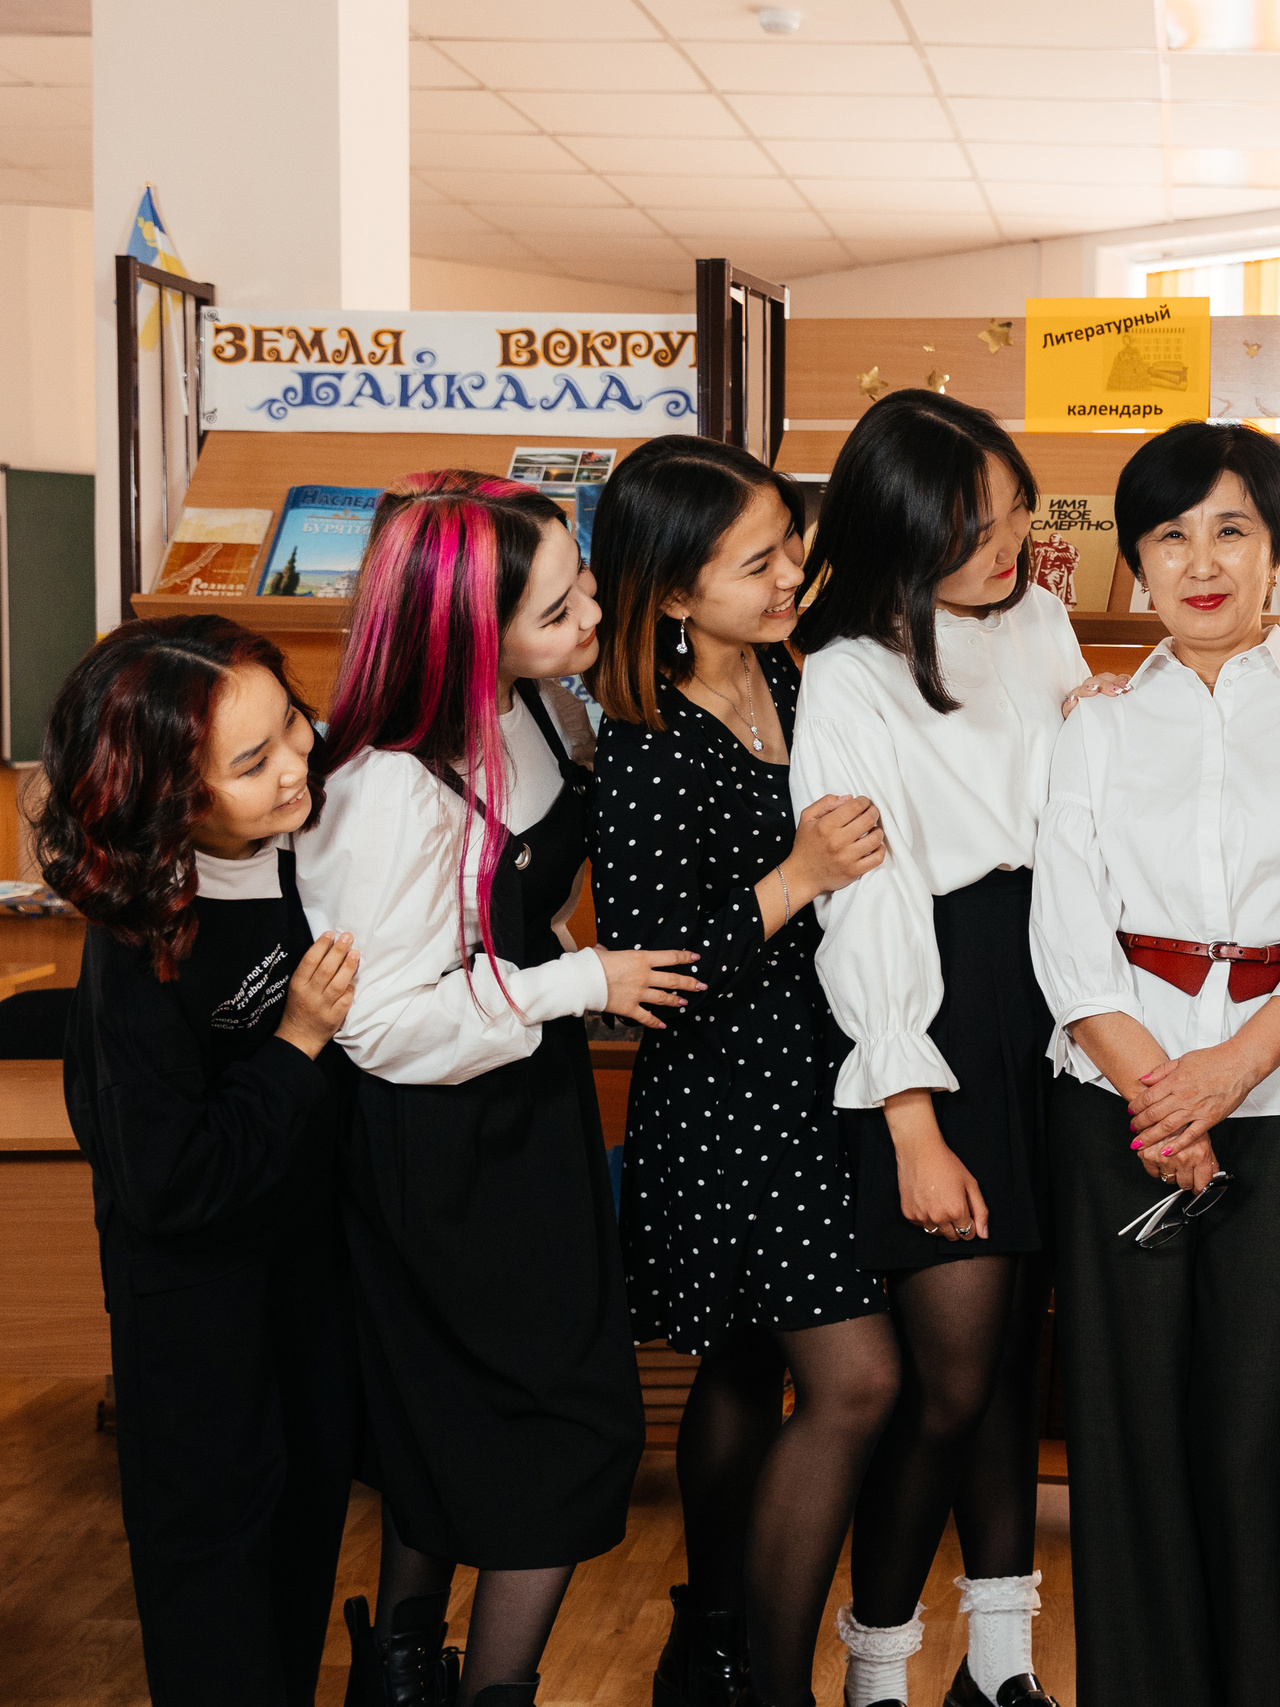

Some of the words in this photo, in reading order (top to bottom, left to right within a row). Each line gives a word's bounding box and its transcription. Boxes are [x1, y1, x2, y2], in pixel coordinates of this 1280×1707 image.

[1042, 304, 1171, 349] Литературный
[211, 322, 406, 366] ЗЕМЛЯ
[282, 348, 643, 415] БАЙКАЛА
[1067, 404, 1163, 419] календарь
[1049, 499, 1087, 510] ИМЯ
[1049, 509, 1091, 520] ТВОЕ
[246, 965, 264, 982] not
[261, 943, 281, 969] about
[247, 973, 269, 998] about
